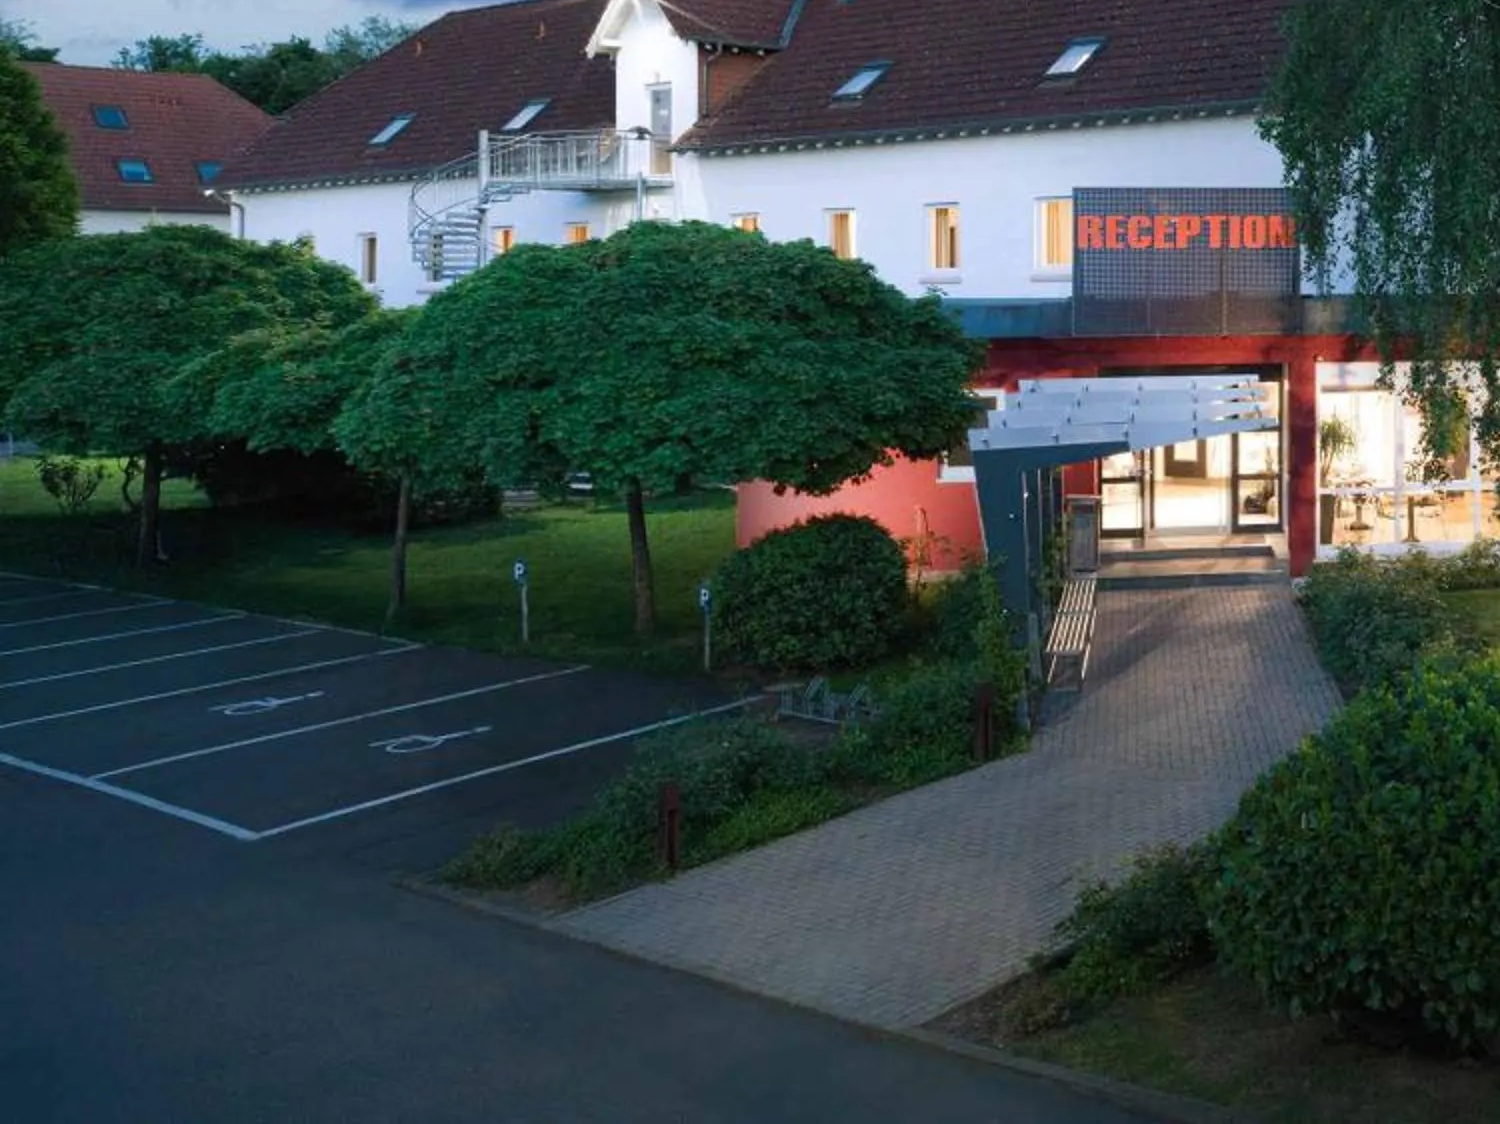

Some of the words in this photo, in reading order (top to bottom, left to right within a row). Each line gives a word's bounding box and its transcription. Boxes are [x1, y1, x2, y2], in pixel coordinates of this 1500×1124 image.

[1077, 214, 1296, 249] RECEPTION
[514, 563, 524, 580] P
[700, 588, 709, 605] P
